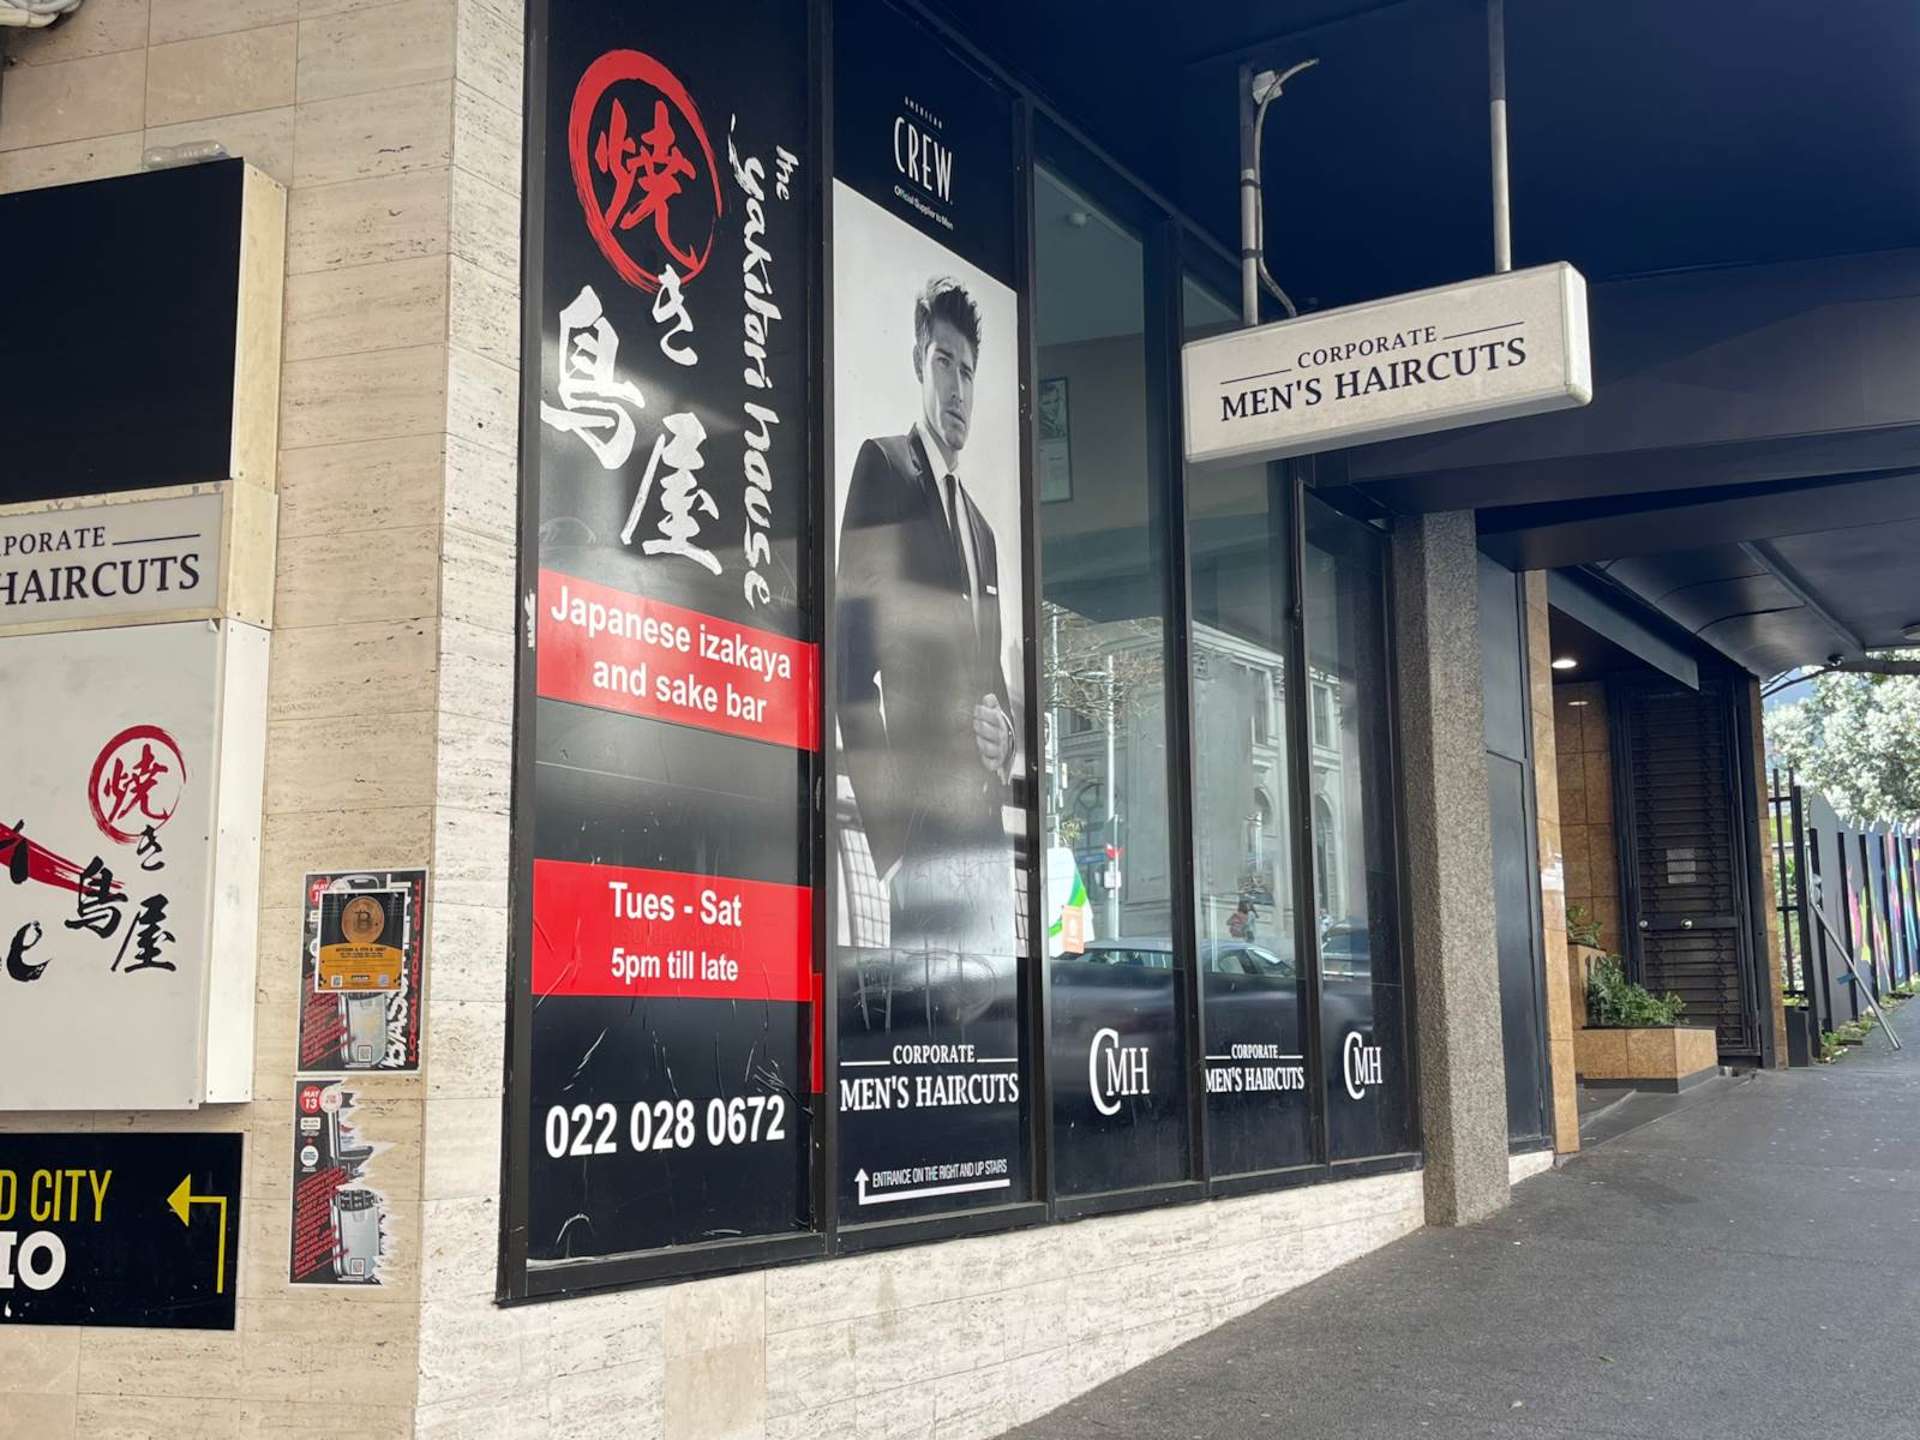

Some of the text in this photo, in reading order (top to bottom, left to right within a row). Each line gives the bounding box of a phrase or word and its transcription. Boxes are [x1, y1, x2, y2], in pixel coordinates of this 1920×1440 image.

[894, 116, 952, 202] CREW
[728, 113, 782, 389] yakitori
[1297, 326, 1437, 369] CORPORATE
[1220, 337, 1527, 422] MEN'S HAIRCUTS
[744, 402, 780, 609] house
[0, 526, 106, 557] PORATE
[551, 585, 791, 683] Japanese izakaya
[593, 660, 768, 723] and sake bar
[608, 881, 742, 927] Tues - Sat
[611, 947, 739, 985] 5pm till late
[893, 1045, 975, 1064] CORPORATE
[1089, 1028, 1150, 1116] CMH
[1231, 1044, 1279, 1060] CORPORATE
[1343, 1031, 1383, 1100] CMH
[840, 1073, 1019, 1111] MEN'S HAIRCUTS
[1205, 1066, 1304, 1093] MEN'S HAIRCUTS
[545, 1095, 785, 1158] 022 028 0672
[30, 1169, 113, 1223] CITY
[872, 1159, 1007, 1188] ENTRANCE ON THE RIGHT AND UP STAIRS
